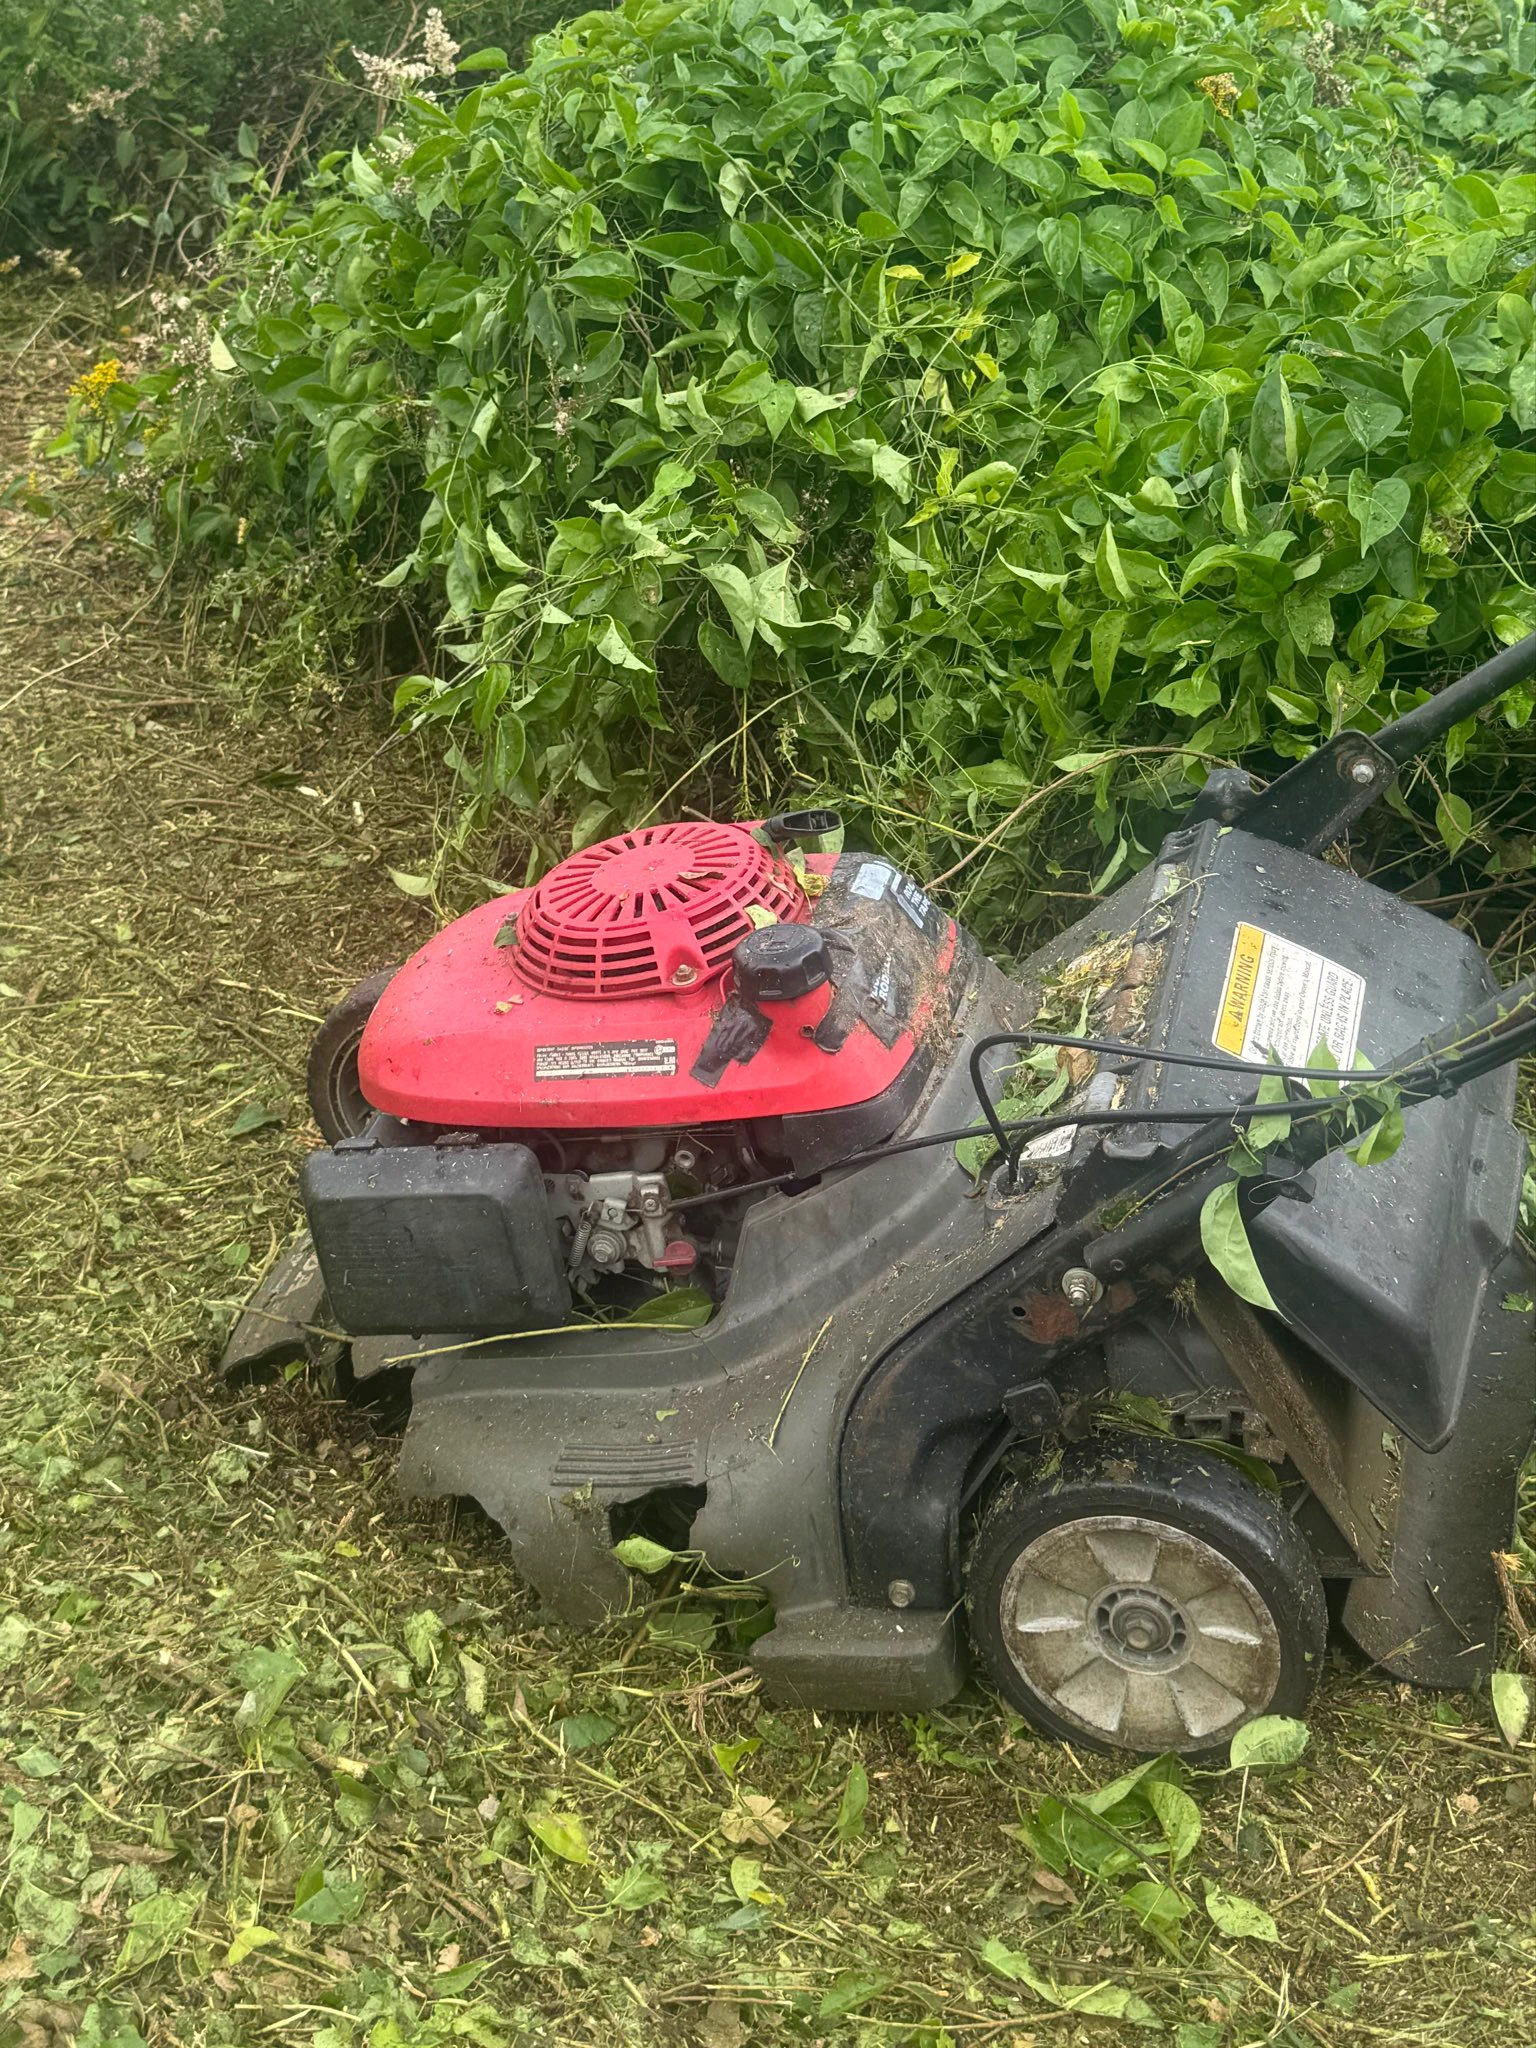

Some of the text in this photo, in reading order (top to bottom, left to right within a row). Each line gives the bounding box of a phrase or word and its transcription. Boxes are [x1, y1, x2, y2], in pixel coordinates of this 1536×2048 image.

[1228, 953, 1254, 1011] WARNING
[1324, 971, 1338, 996] GUARD
[1338, 1002, 1349, 1014] IN
[1333, 1021, 1346, 1040] BAG
[1331, 1039, 1343, 1053] OR
